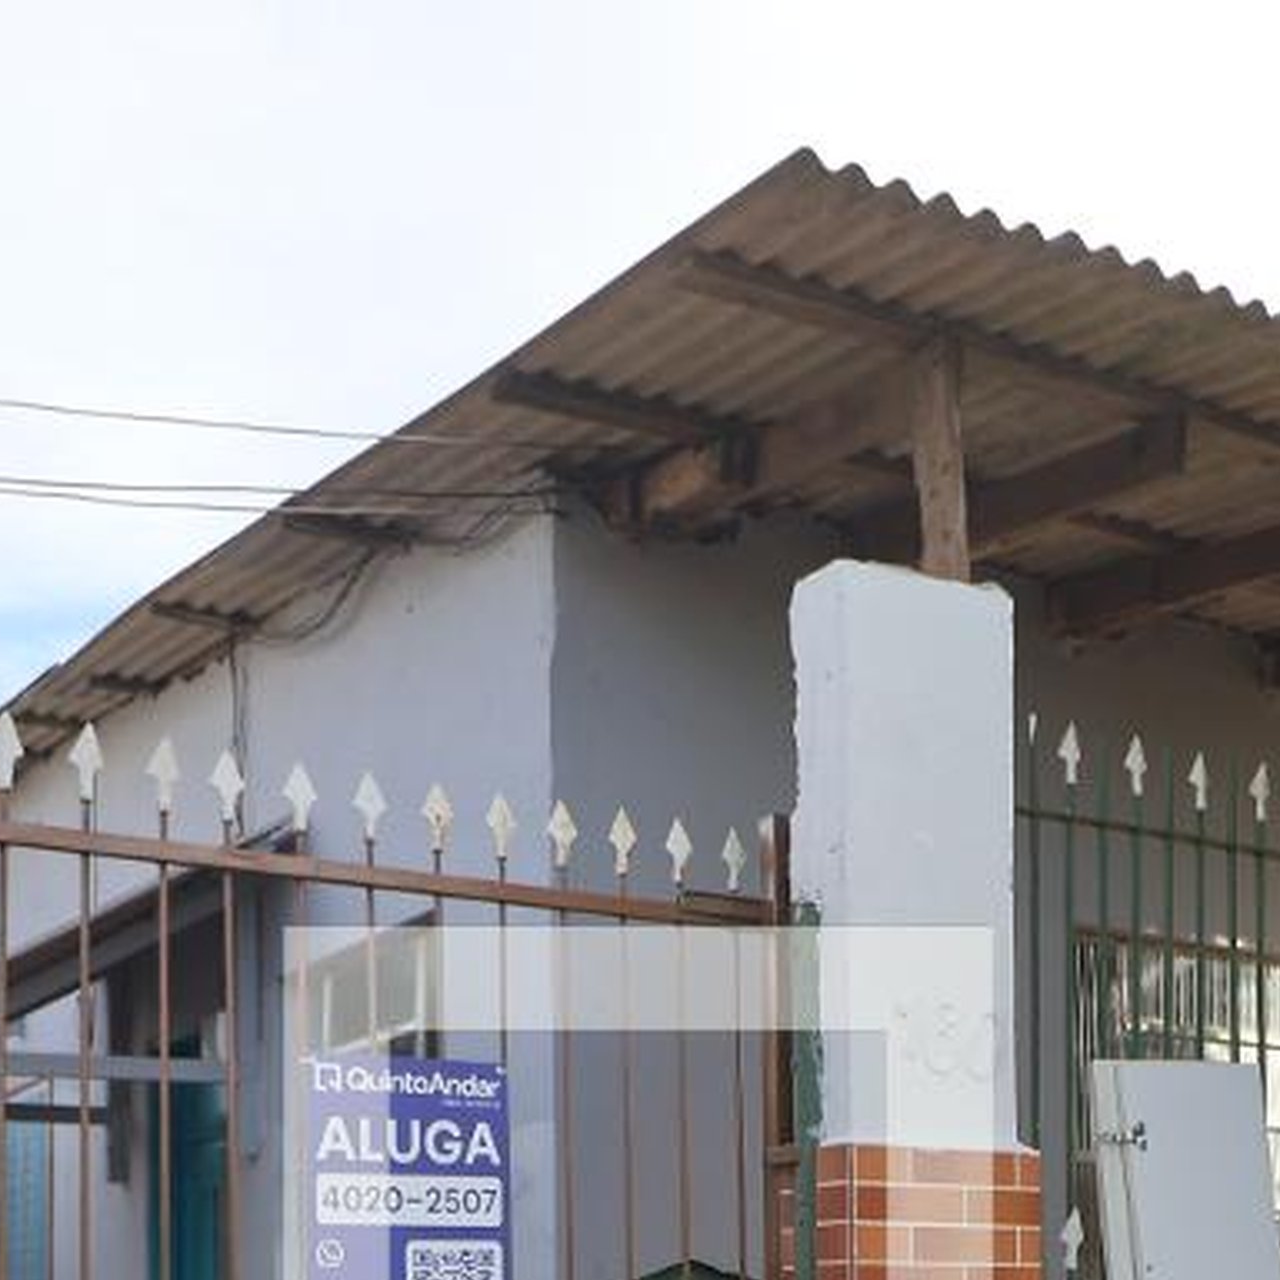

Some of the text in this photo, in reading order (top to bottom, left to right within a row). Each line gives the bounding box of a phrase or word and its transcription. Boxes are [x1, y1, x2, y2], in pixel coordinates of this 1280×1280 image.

[346, 1066, 500, 1098] QuintoAndar
[316, 1117, 501, 1166] ALUGA
[321, 1186, 498, 1215] 4020-2507
